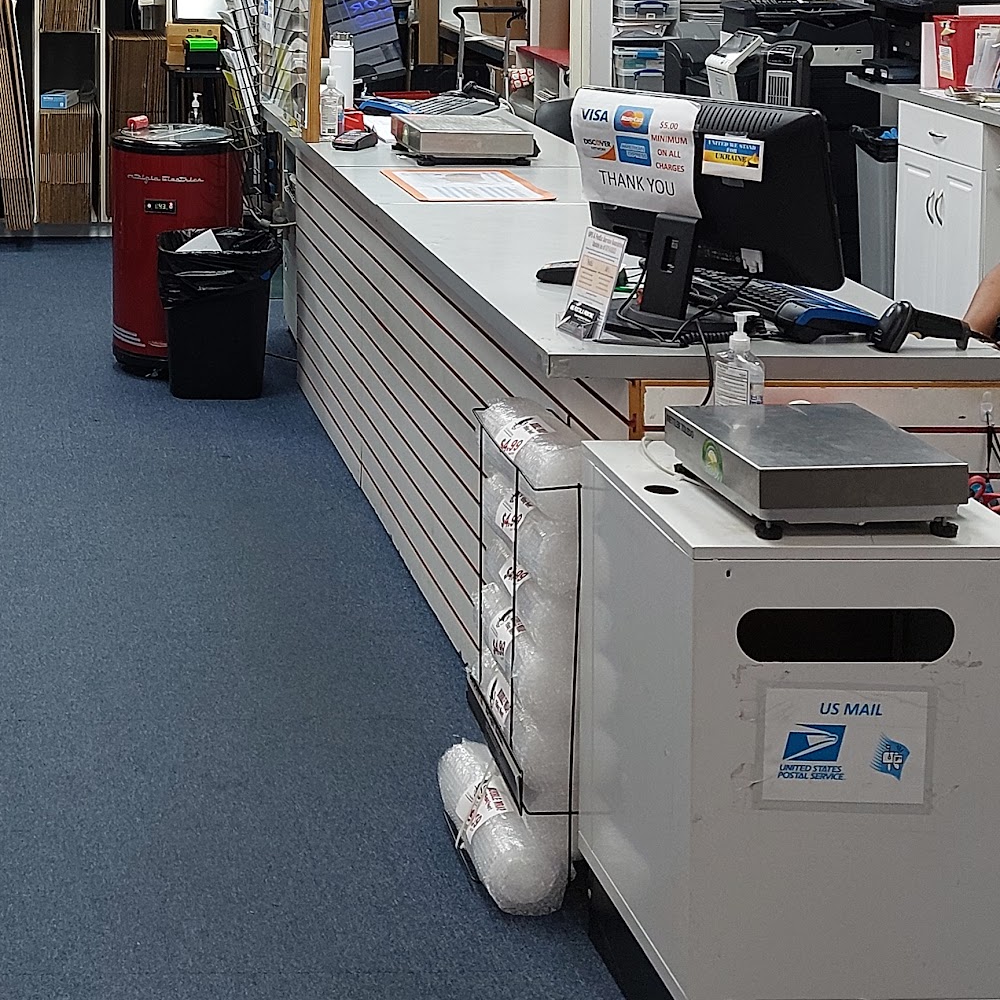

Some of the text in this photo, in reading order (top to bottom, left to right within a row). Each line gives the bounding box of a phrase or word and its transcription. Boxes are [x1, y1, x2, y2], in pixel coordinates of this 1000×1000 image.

[581, 108, 608, 122] VISA
[660, 120, 678, 130] $5.00
[583, 138, 612, 148] DISCOVER
[650, 134, 688, 144] MINIMUM
[658, 148, 668, 156] ON
[715, 152, 748, 162] UKRAINE
[656, 162, 685, 172] CHARGES
[598, 170, 676, 197] THANK YOU
[820, 702, 883, 716] US MAIL
[780, 764, 842, 773] UNITED STATES
[778, 772, 809, 780] POSTAL
